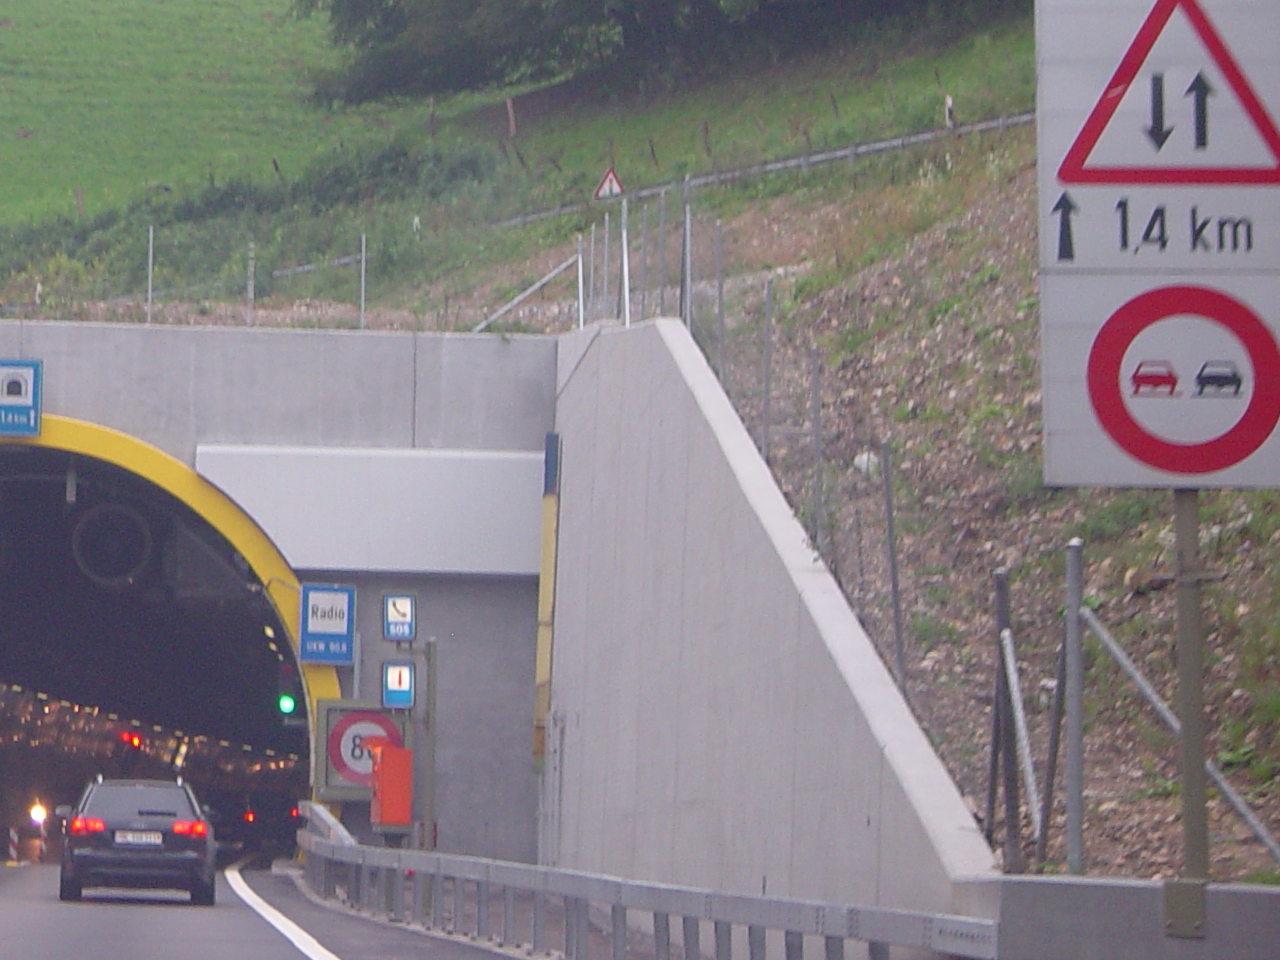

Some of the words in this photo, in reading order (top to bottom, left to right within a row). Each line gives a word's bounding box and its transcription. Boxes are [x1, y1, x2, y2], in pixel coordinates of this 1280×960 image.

[1114, 196, 1169, 254] 1,4
[1189, 205, 1253, 252] km
[311, 603, 346, 621] Radio
[389, 623, 410, 637] SOS
